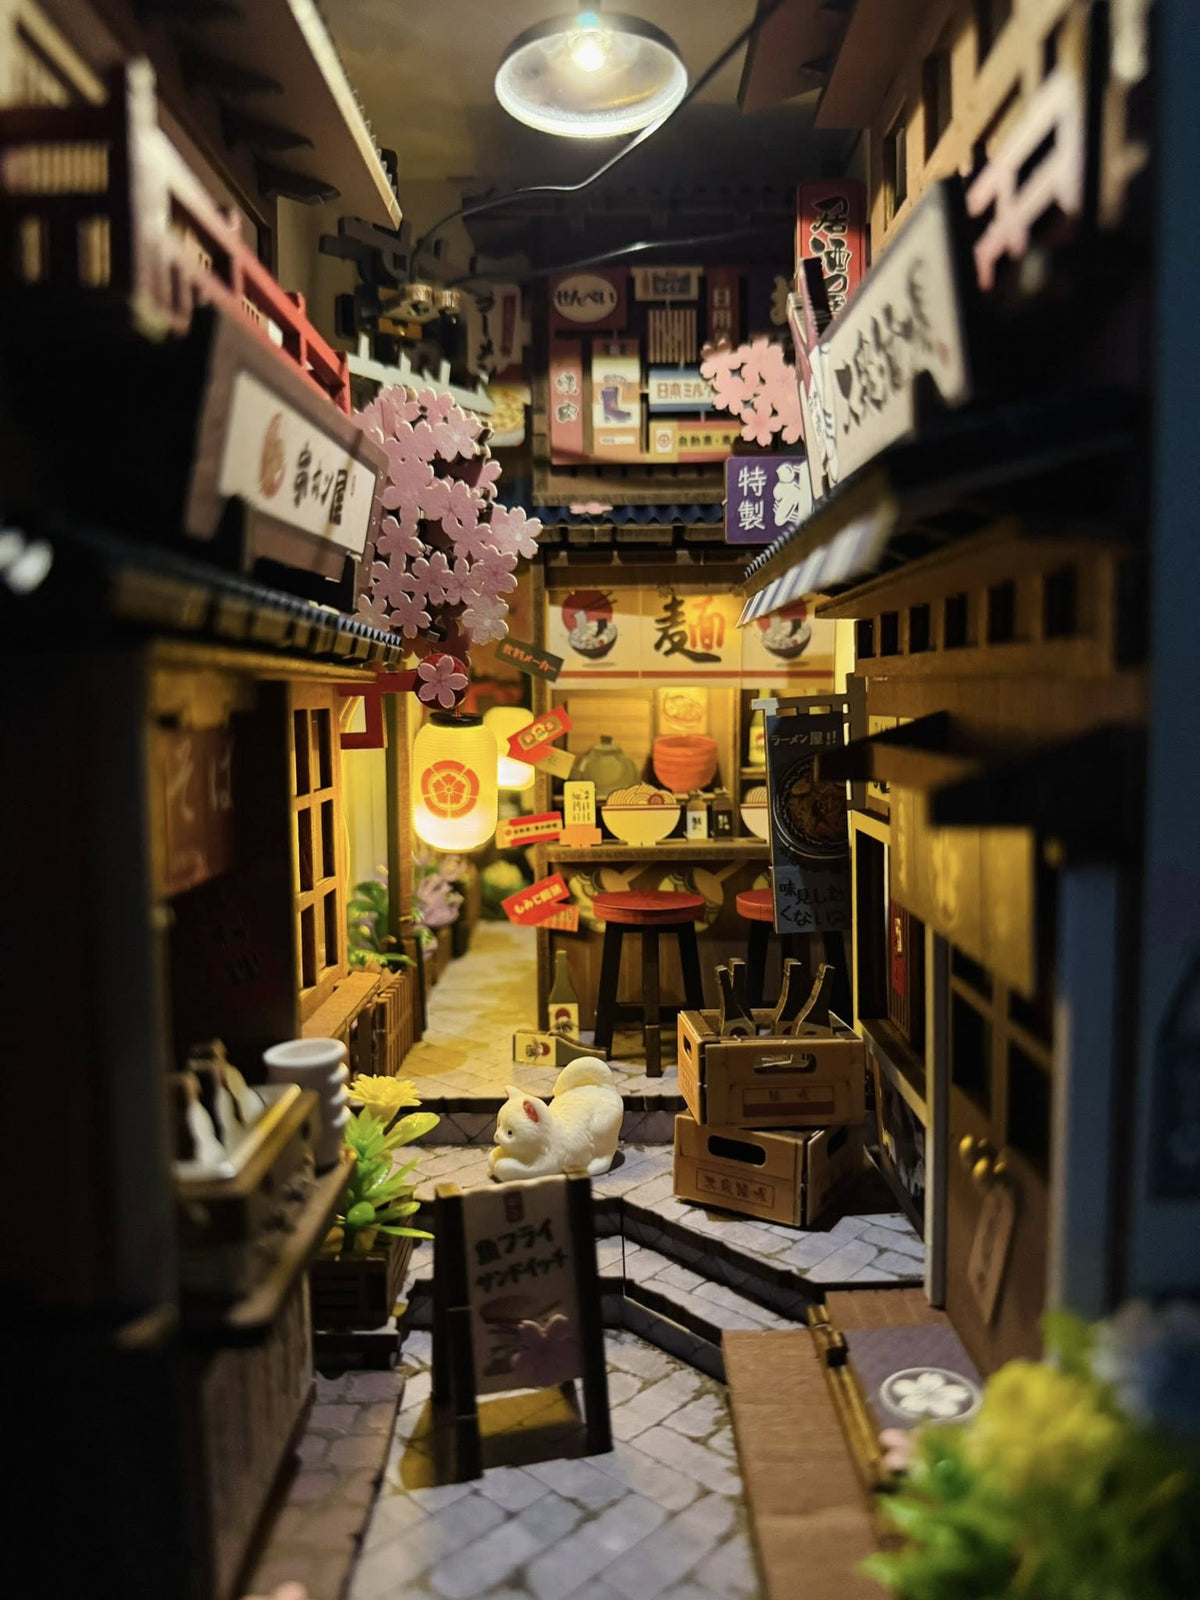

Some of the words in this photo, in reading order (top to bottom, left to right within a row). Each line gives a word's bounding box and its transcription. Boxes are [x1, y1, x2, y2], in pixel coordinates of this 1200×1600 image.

[556, 288, 615, 308] せんべい
[738, 466, 767, 531] 特製
